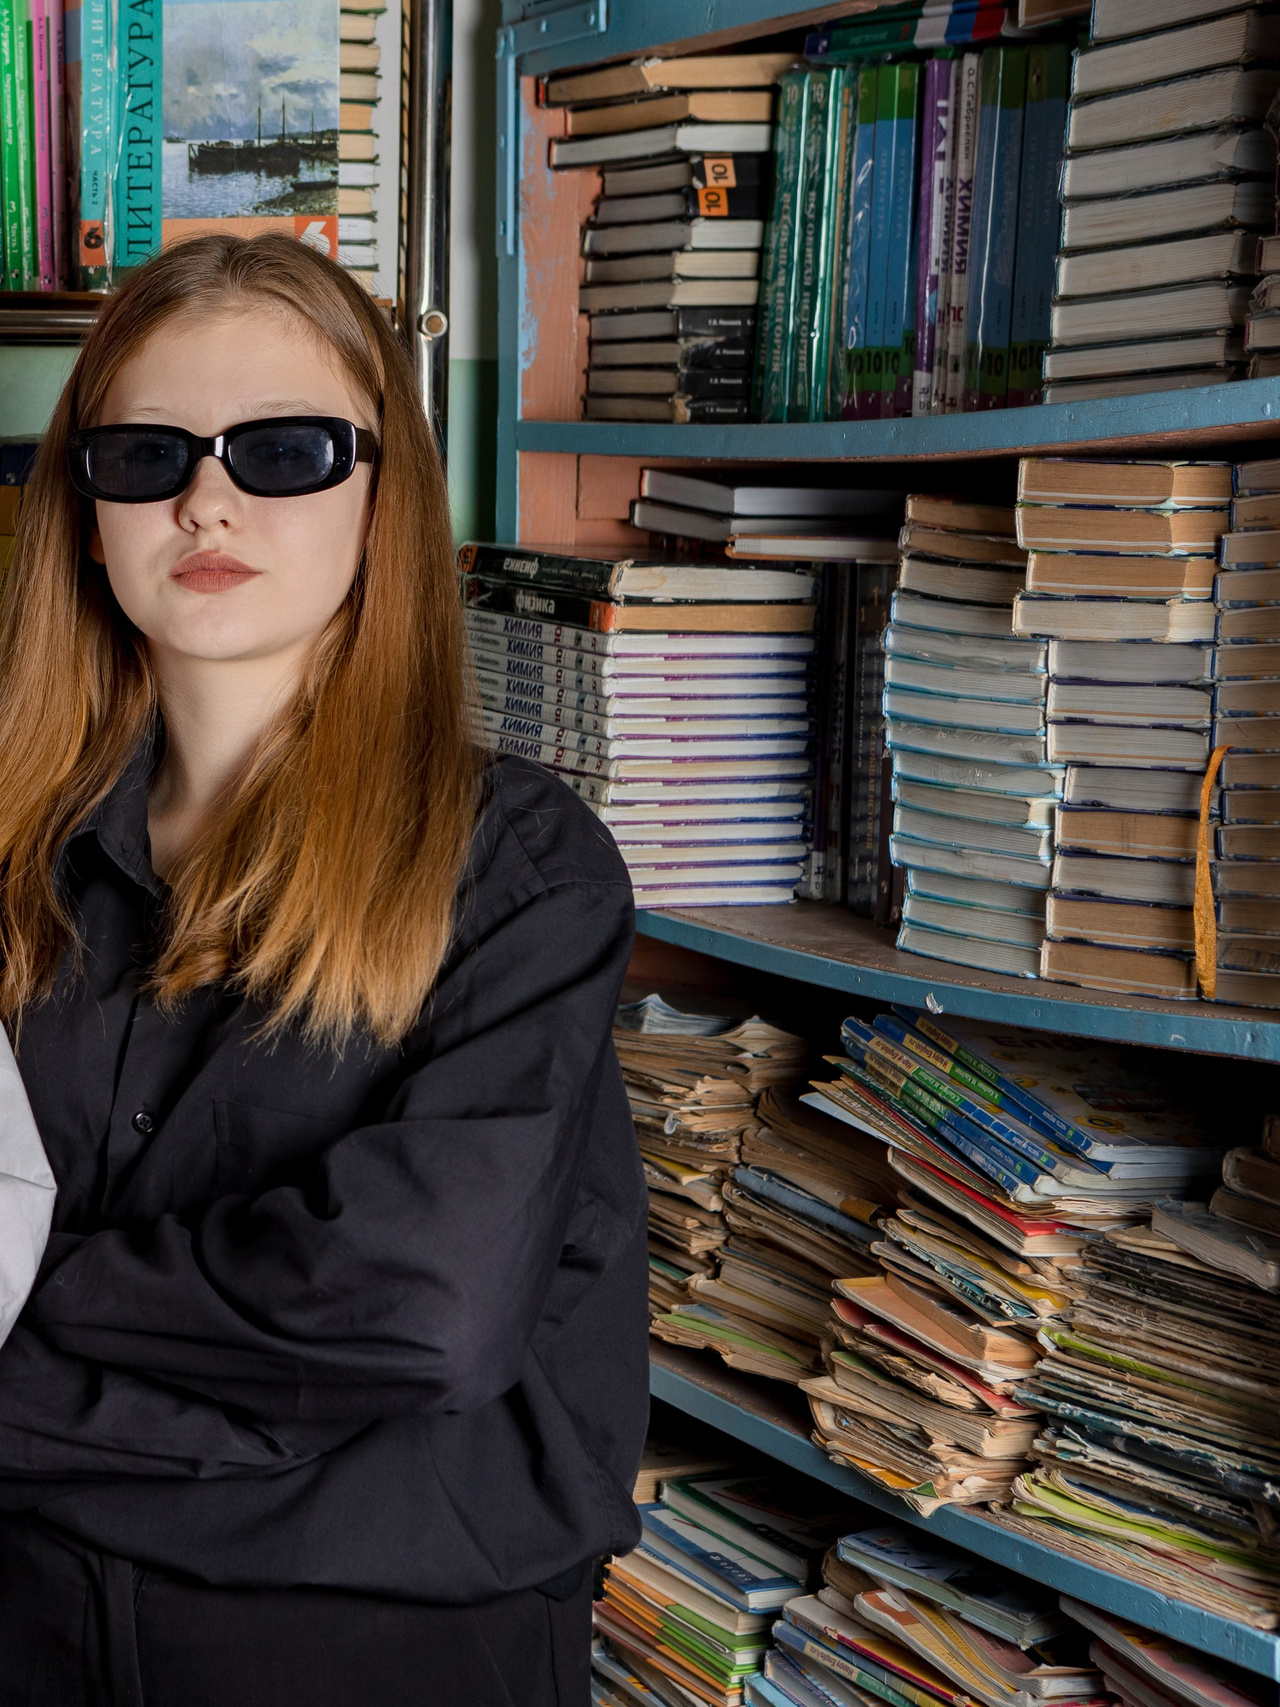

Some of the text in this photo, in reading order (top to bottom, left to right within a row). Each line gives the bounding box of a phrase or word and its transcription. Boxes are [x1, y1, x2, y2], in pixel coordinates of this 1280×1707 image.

[90, 0, 103, 156] ЛИТЕРАТУРА
[91, 170, 99, 197] ЧАСТЬ
[712, 163, 728, 184] 10
[706, 191, 722, 212] 10
[83, 226, 103, 249] 6
[955, 178, 973, 275] ХИМИЯ
[299, 221, 331, 256] 6
[866, 351, 883, 374] 10
[885, 351, 901, 374] 10
[985, 352, 1004, 377] 10
[503, 556, 539, 580] физика
[515, 589, 555, 615] физика
[503, 617, 543, 640] ХИМИЯ
[554, 626, 563, 644] 10
[506, 638, 544, 661] ХИМИЯ
[556, 649, 563, 664] 10
[506, 658, 544, 681] ХИМИЯ
[556, 669, 563, 684] 10
[506, 678, 545, 700] ХИМИЯ
[556, 689, 564, 705] 10
[504, 696, 542, 719] ХИМИЯ
[500, 716, 544, 739] ХИМИЯ
[497, 735, 542, 760] ХИМИЯ
[554, 747, 565, 765] 10
[933, 1052, 948, 1068] Happy
